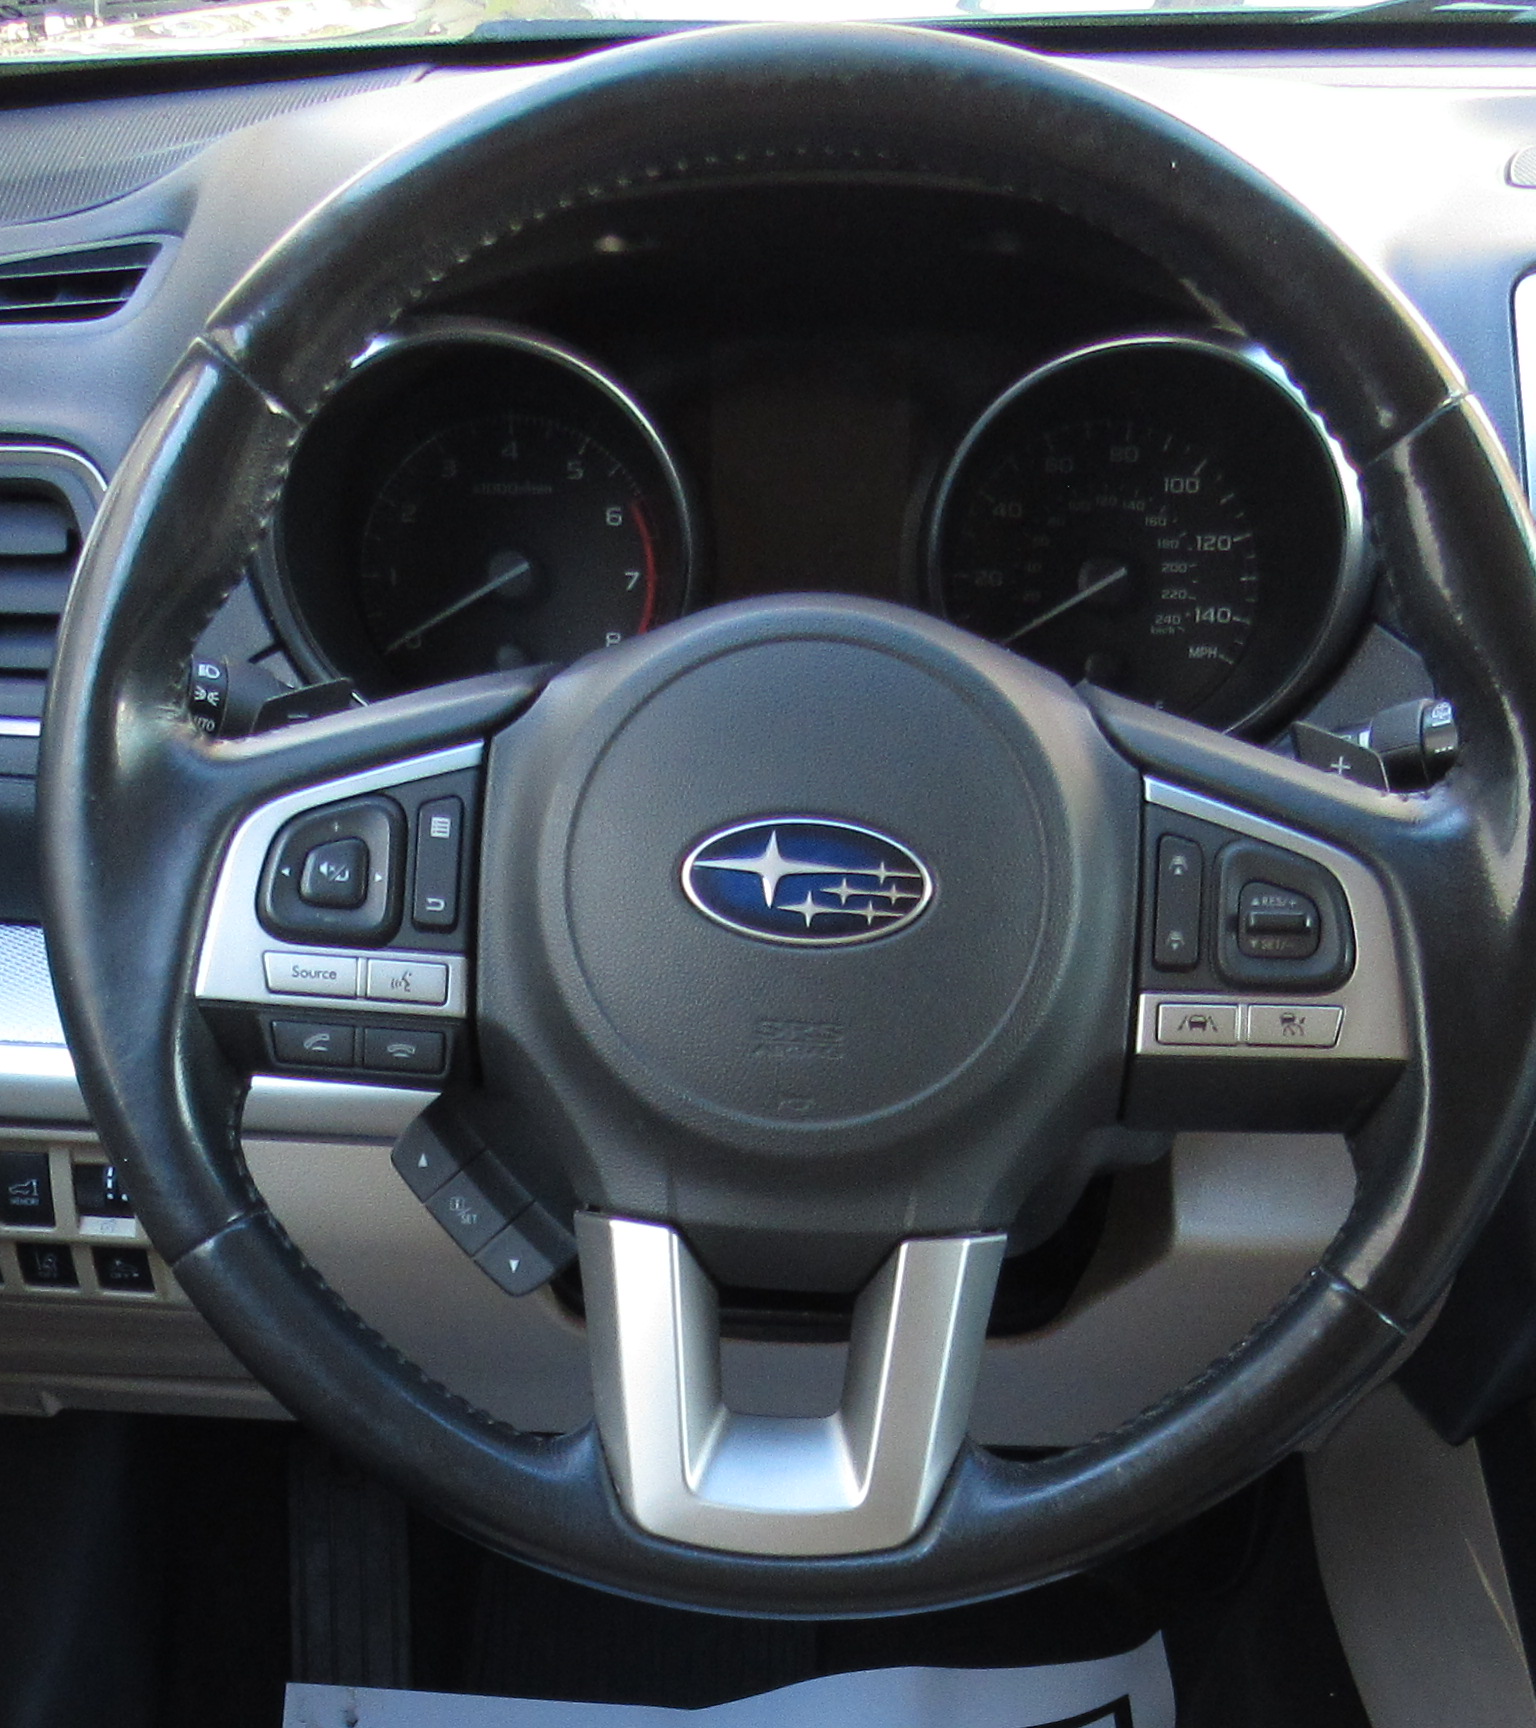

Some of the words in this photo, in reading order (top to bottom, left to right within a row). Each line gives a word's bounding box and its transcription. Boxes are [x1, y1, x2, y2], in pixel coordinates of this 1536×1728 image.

[567, 459, 584, 480] 5
[1164, 477, 1200, 494] 100
[605, 506, 622, 526] 6
[1196, 535, 1232, 551] 120
[624, 571, 640, 591] 7
[1193, 607, 1232, 623] 140
[1188, 646, 1218, 659] MPH
[291, 965, 338, 980] Source
